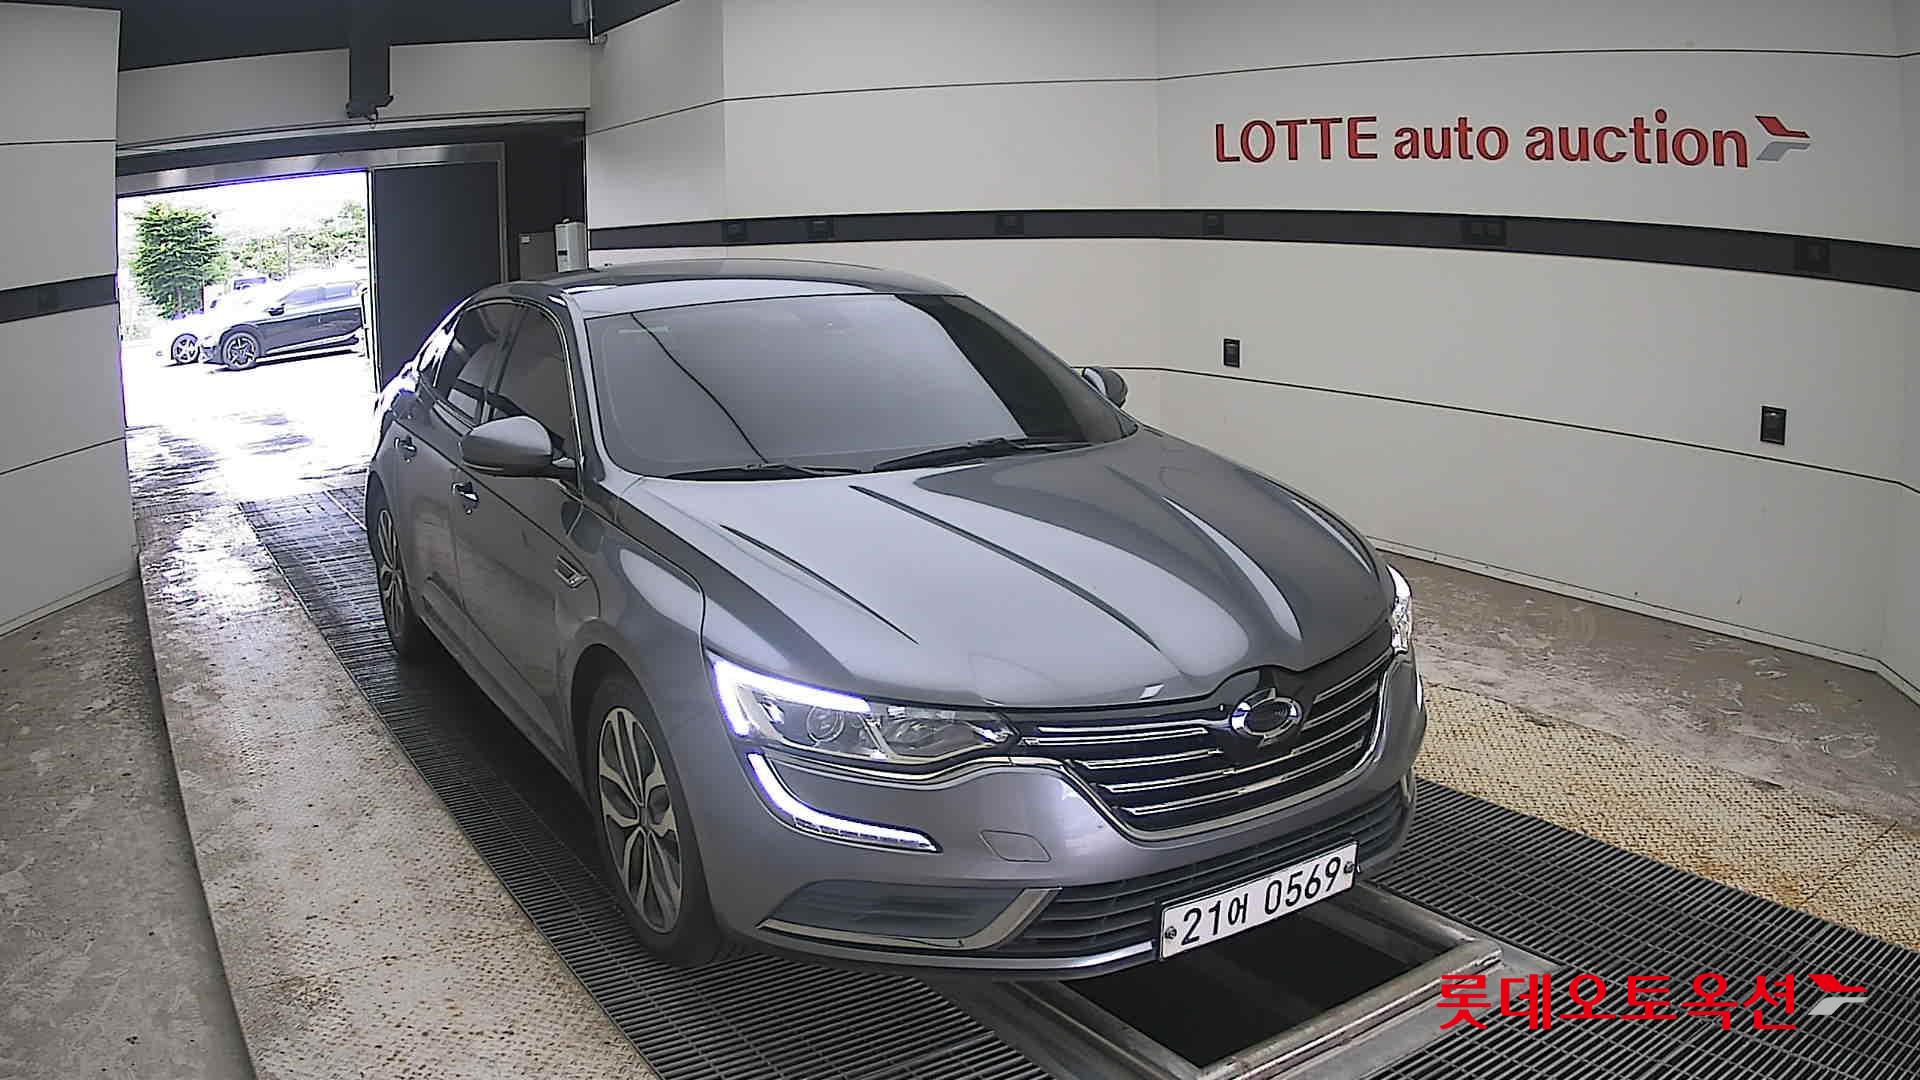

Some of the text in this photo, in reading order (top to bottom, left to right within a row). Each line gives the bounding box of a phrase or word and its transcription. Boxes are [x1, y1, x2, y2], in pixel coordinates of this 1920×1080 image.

[1215, 108, 1748, 168] LOTTE auto auction
[1180, 856, 1342, 946] 21어 0569
